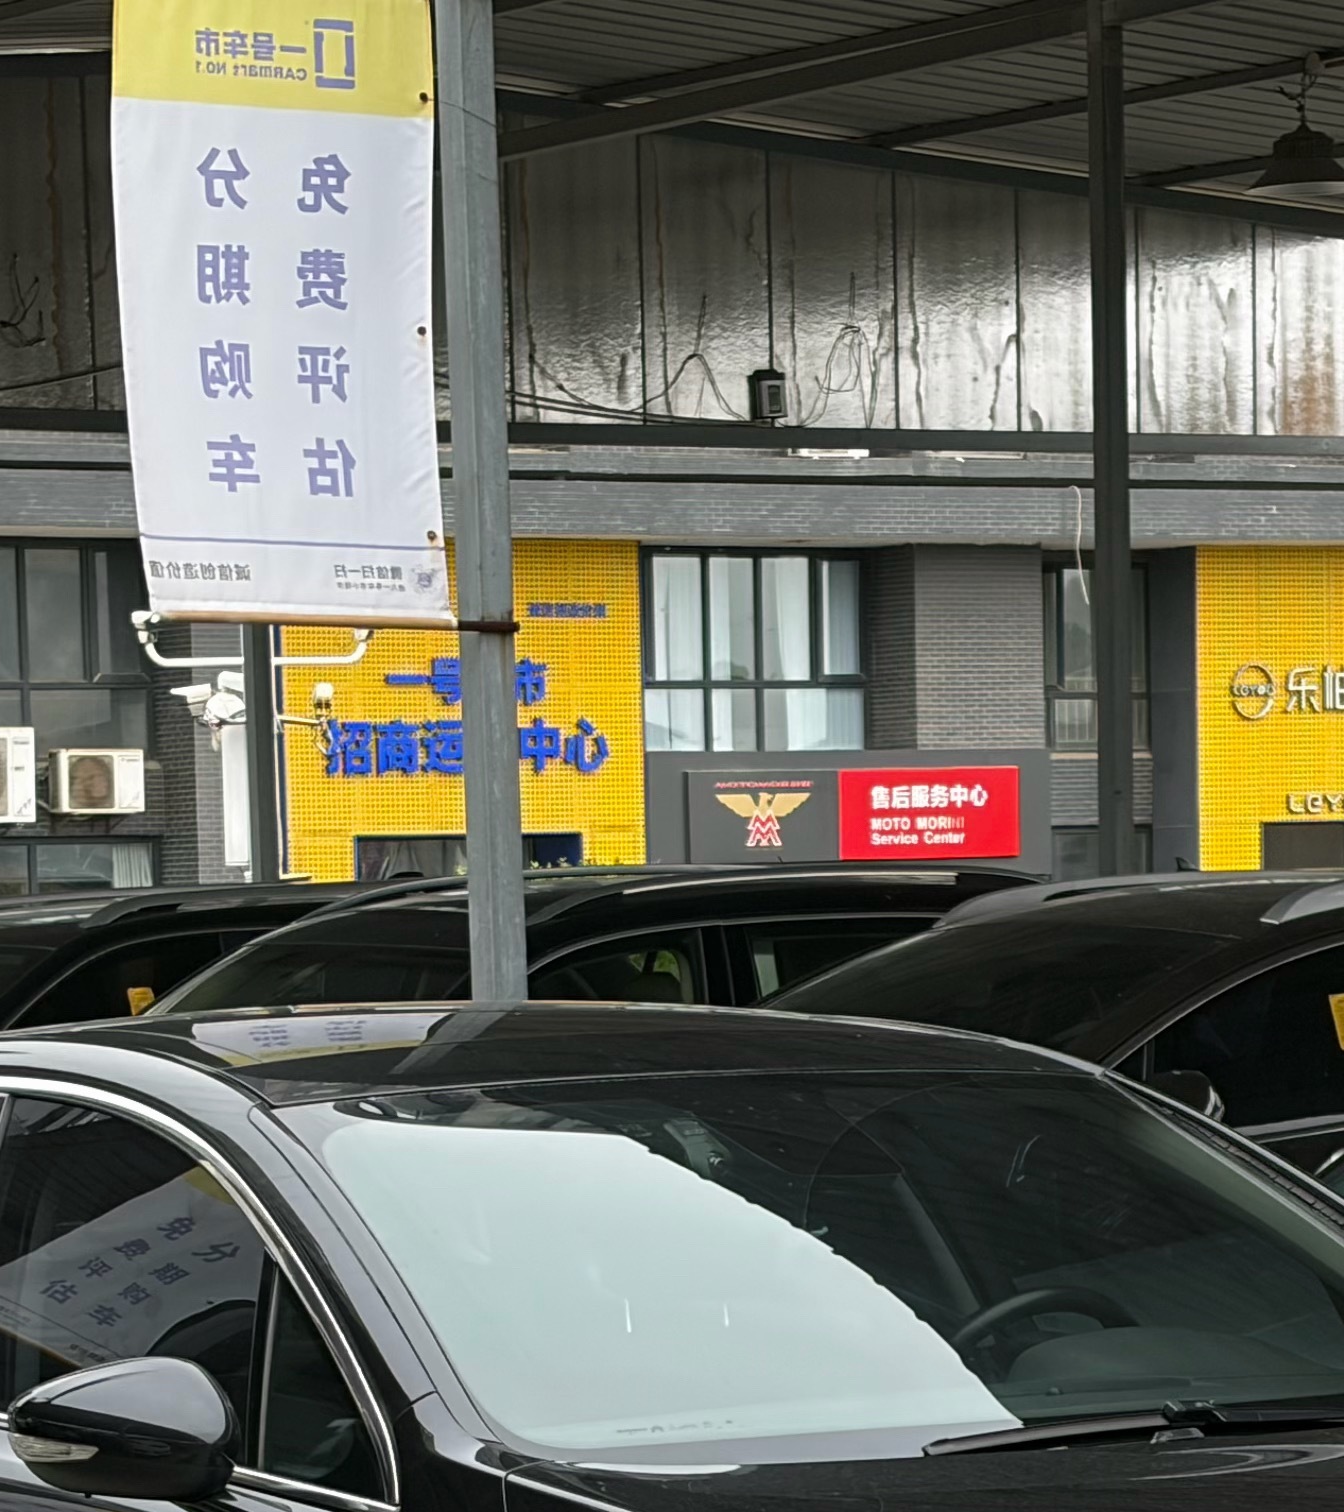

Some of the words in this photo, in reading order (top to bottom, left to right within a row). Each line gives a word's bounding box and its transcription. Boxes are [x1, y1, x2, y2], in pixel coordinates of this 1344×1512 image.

[385, 656, 548, 706] 一号市
[326, 716, 610, 776] 招商运中心
[871, 784, 989, 809] 售后服务中心
[870, 817, 911, 830] MOTO
[870, 832, 919, 845] Service
[923, 831, 966, 844] Center
